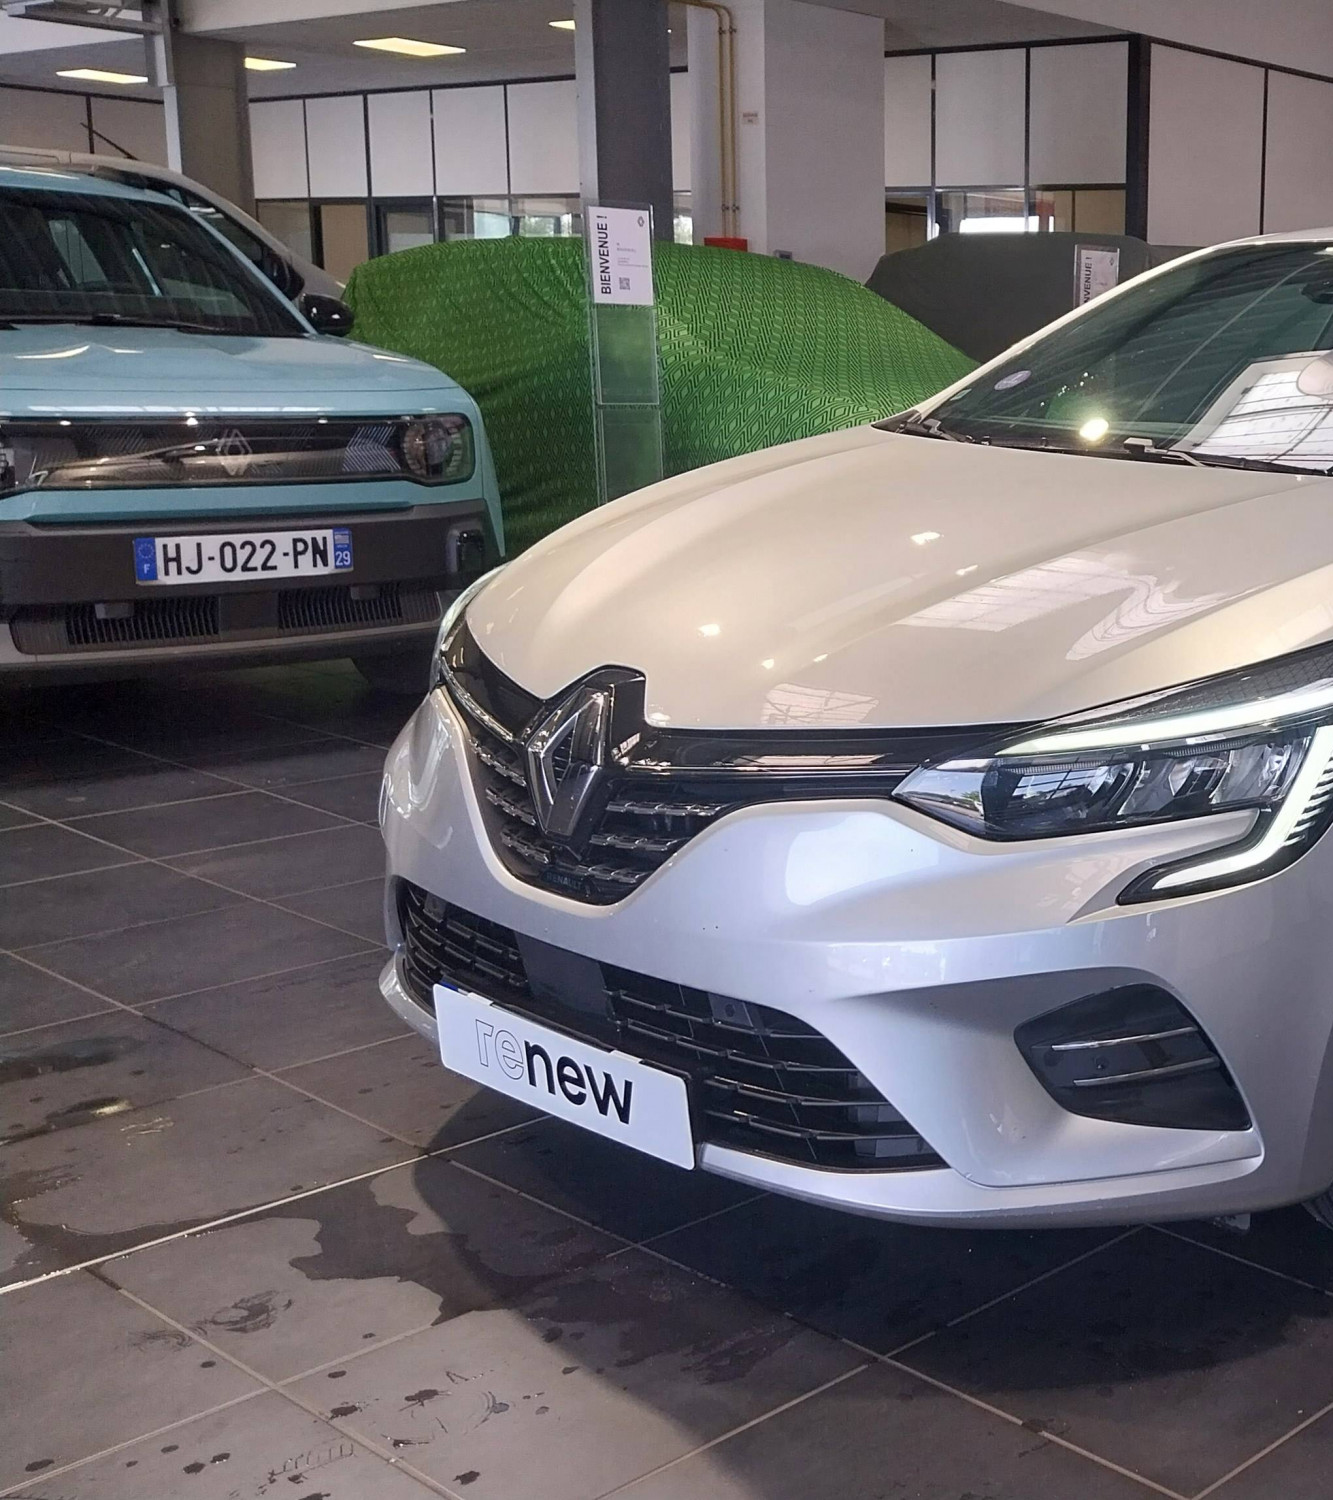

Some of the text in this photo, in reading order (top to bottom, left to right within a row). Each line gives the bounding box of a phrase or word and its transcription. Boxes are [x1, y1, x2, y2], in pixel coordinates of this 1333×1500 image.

[596, 222, 612, 295] BIENVENUE
[1083, 262, 1093, 304] NVENUE
[143, 563, 151, 574] F
[162, 536, 329, 577] HJ-022-PN
[335, 550, 351, 566] 29
[475, 1019, 634, 1126] renew
